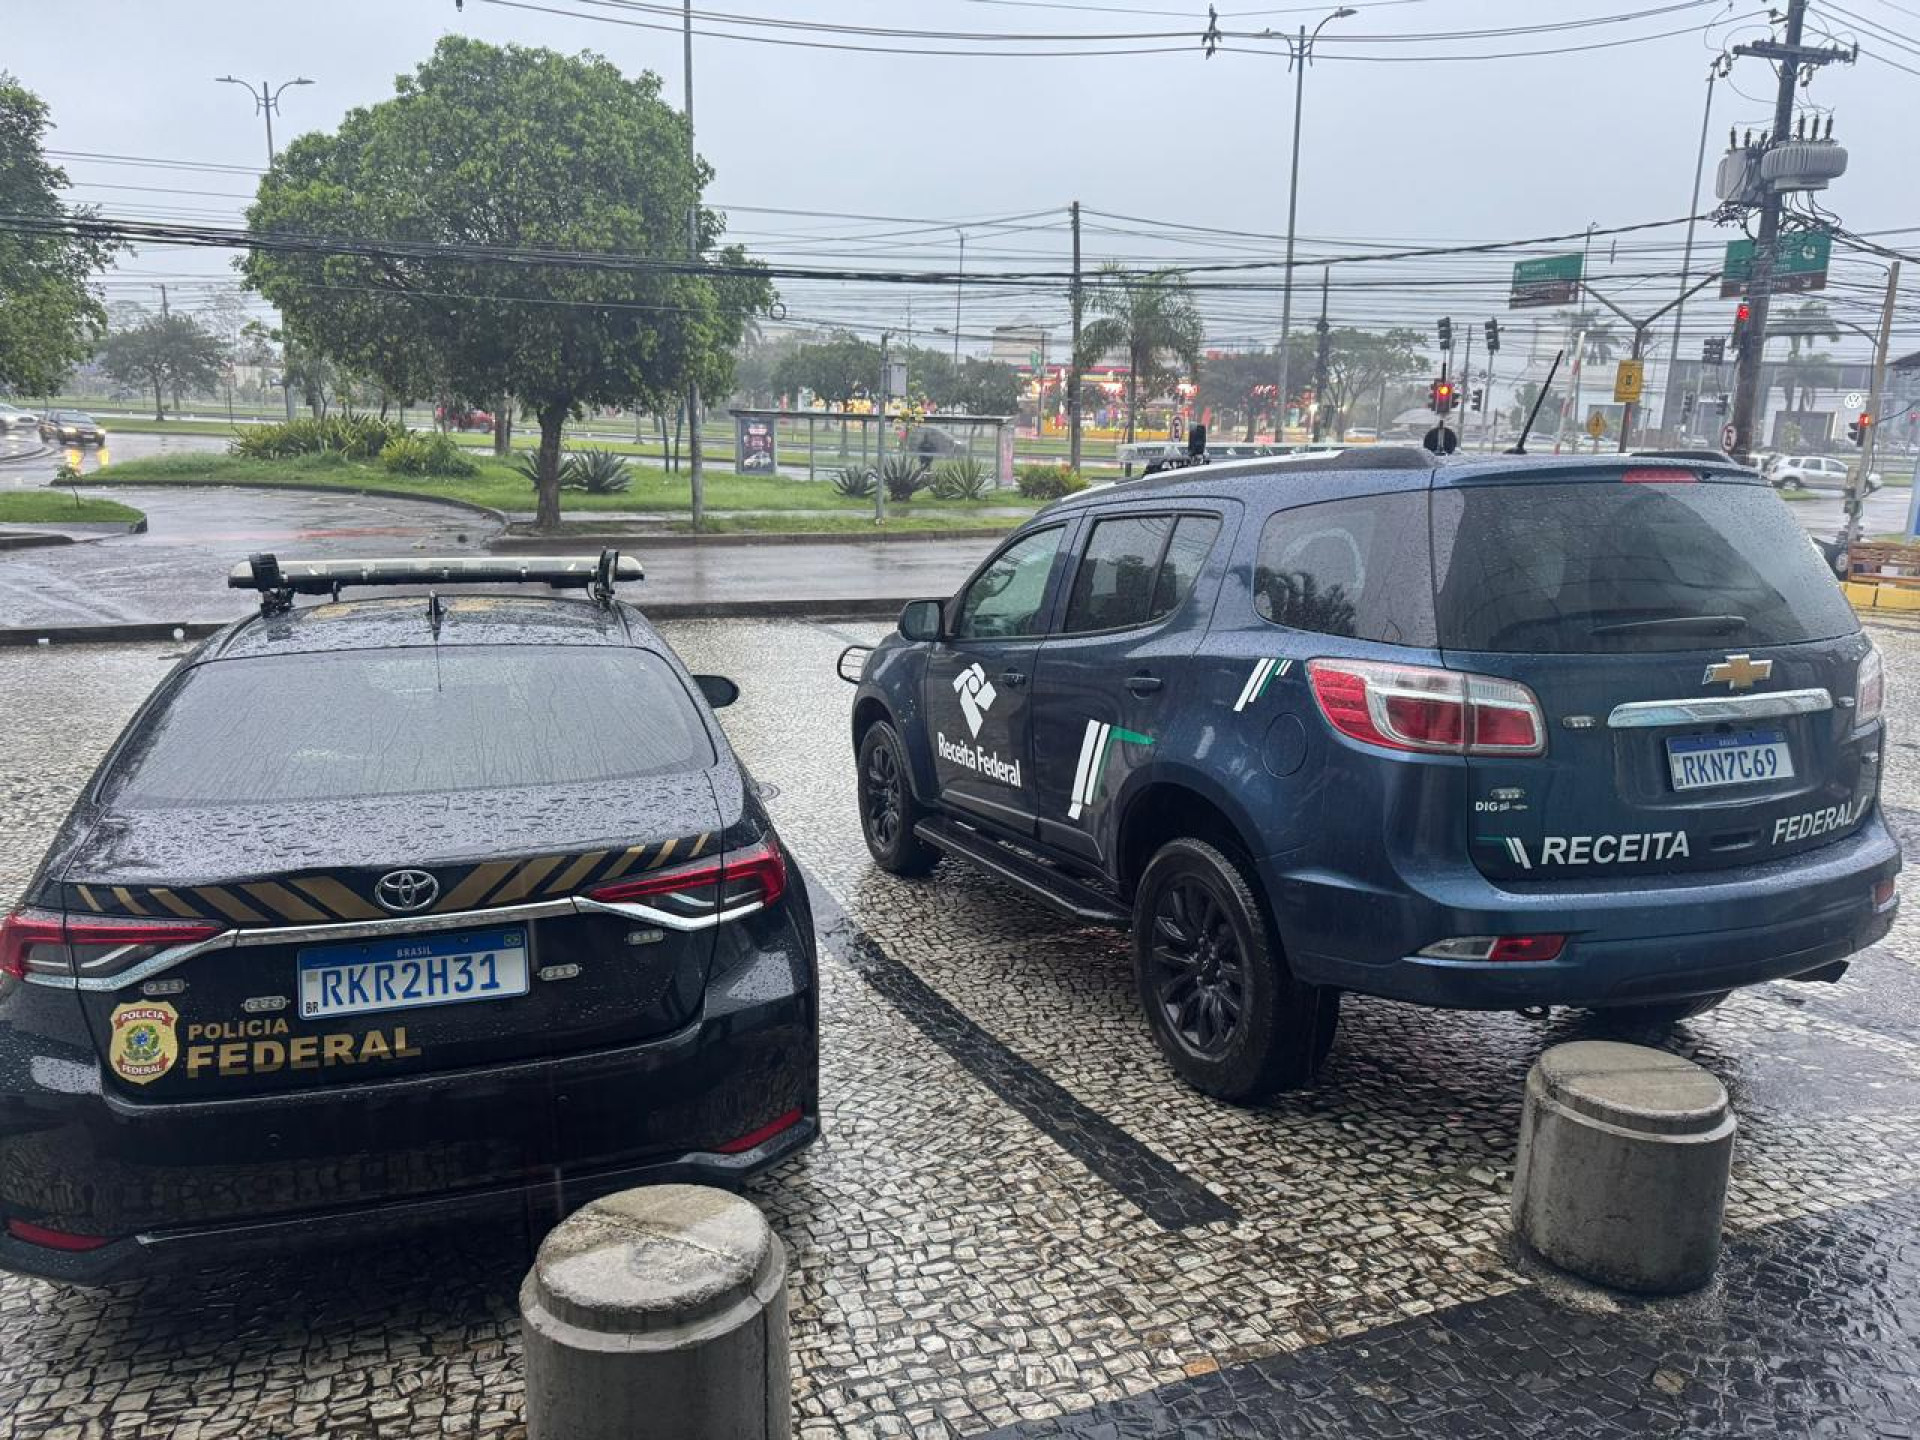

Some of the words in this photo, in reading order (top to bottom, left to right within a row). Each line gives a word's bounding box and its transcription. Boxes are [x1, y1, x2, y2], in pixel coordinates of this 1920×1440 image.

[937, 732, 976, 770] Receita
[977, 745, 1021, 787] Federal
[1682, 748, 1777, 784] RKN7C69
[1541, 830, 1690, 865] RECEITA
[1772, 801, 1853, 845] FEDERAL
[397, 945, 432, 958] BRASIL
[321, 953, 500, 1007] RKR2H31
[305, 1001, 319, 1014] BR
[122, 1063, 162, 1075] FEDERAL
[186, 1027, 421, 1079] FEDERAL
